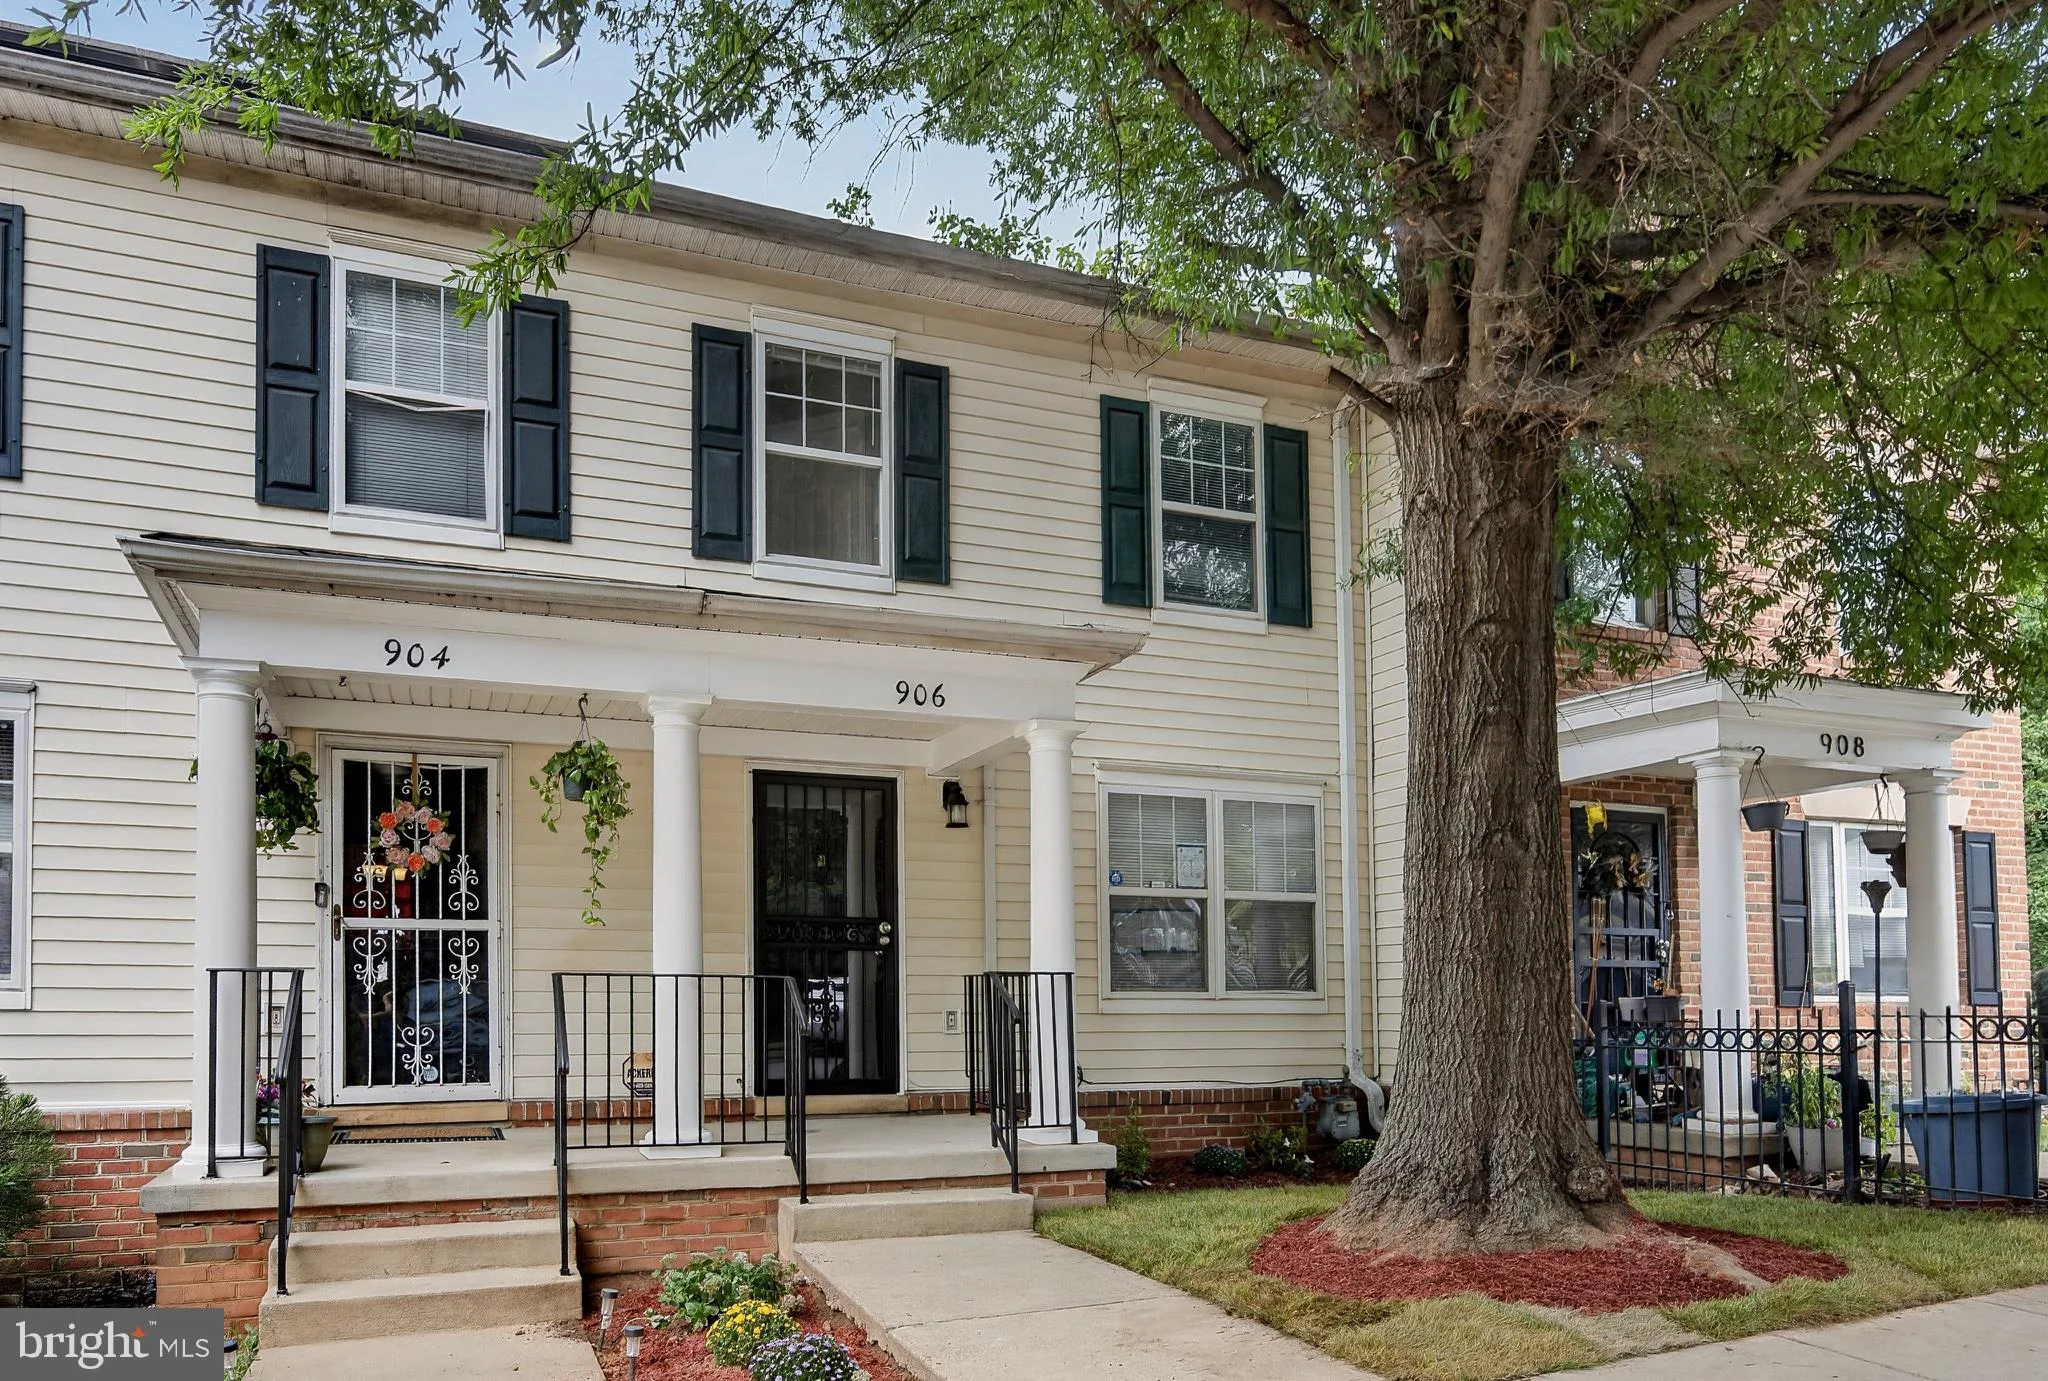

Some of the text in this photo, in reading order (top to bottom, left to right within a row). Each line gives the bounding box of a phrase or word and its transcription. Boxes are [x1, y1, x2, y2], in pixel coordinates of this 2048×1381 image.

[384, 638, 450, 670] 904
[896, 680, 946, 708] 906
[1820, 733, 1865, 758] 908
[627, 1068, 653, 1079] ACKER
